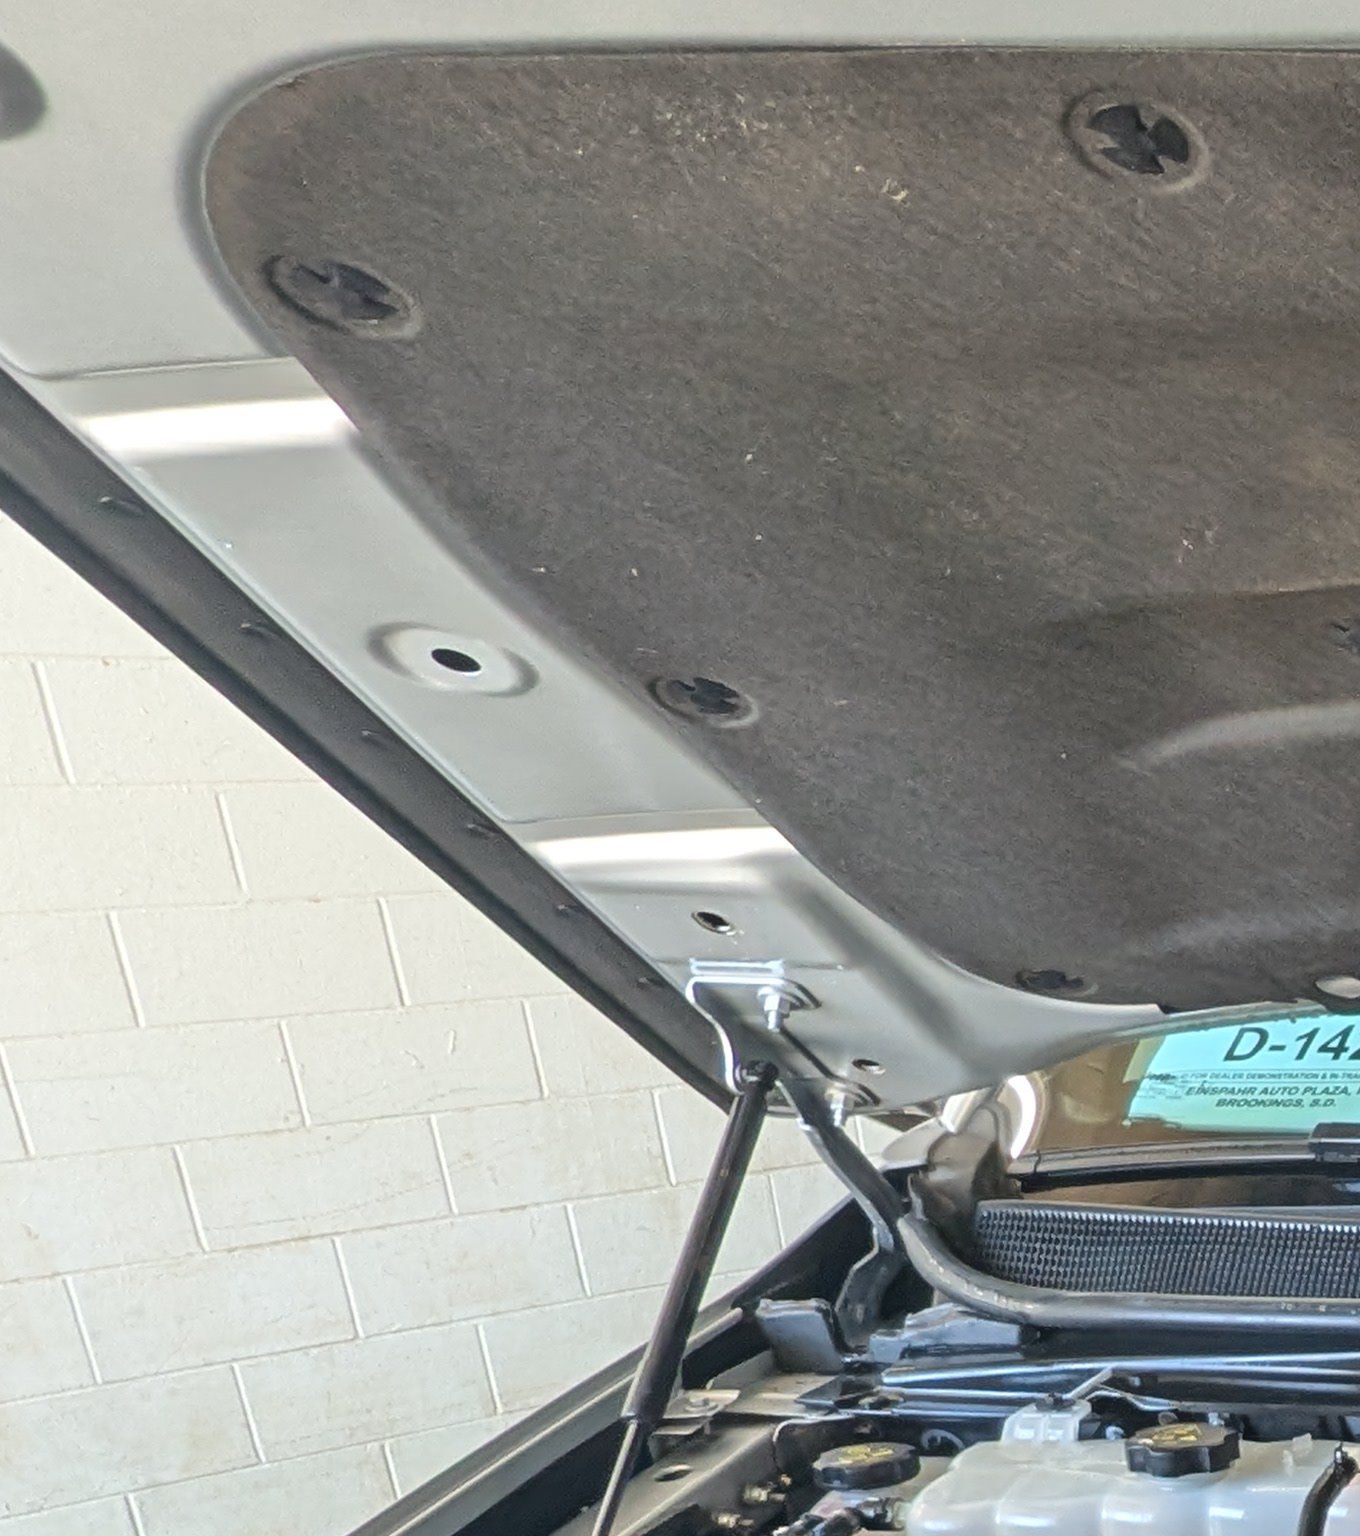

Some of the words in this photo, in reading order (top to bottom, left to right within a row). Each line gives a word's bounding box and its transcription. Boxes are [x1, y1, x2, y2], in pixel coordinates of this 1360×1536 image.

[1209, 1072, 1245, 1080] DEALER
[1246, 1072, 1319, 1080] DEMONSTRATION
[1186, 1086, 1258, 1096] EINSPAHR
[1259, 1086, 1300, 1096] AUTO
[1301, 1085, 1352, 1097] PLAZA,
[1215, 1099, 1305, 1109] BROOKINGS,
